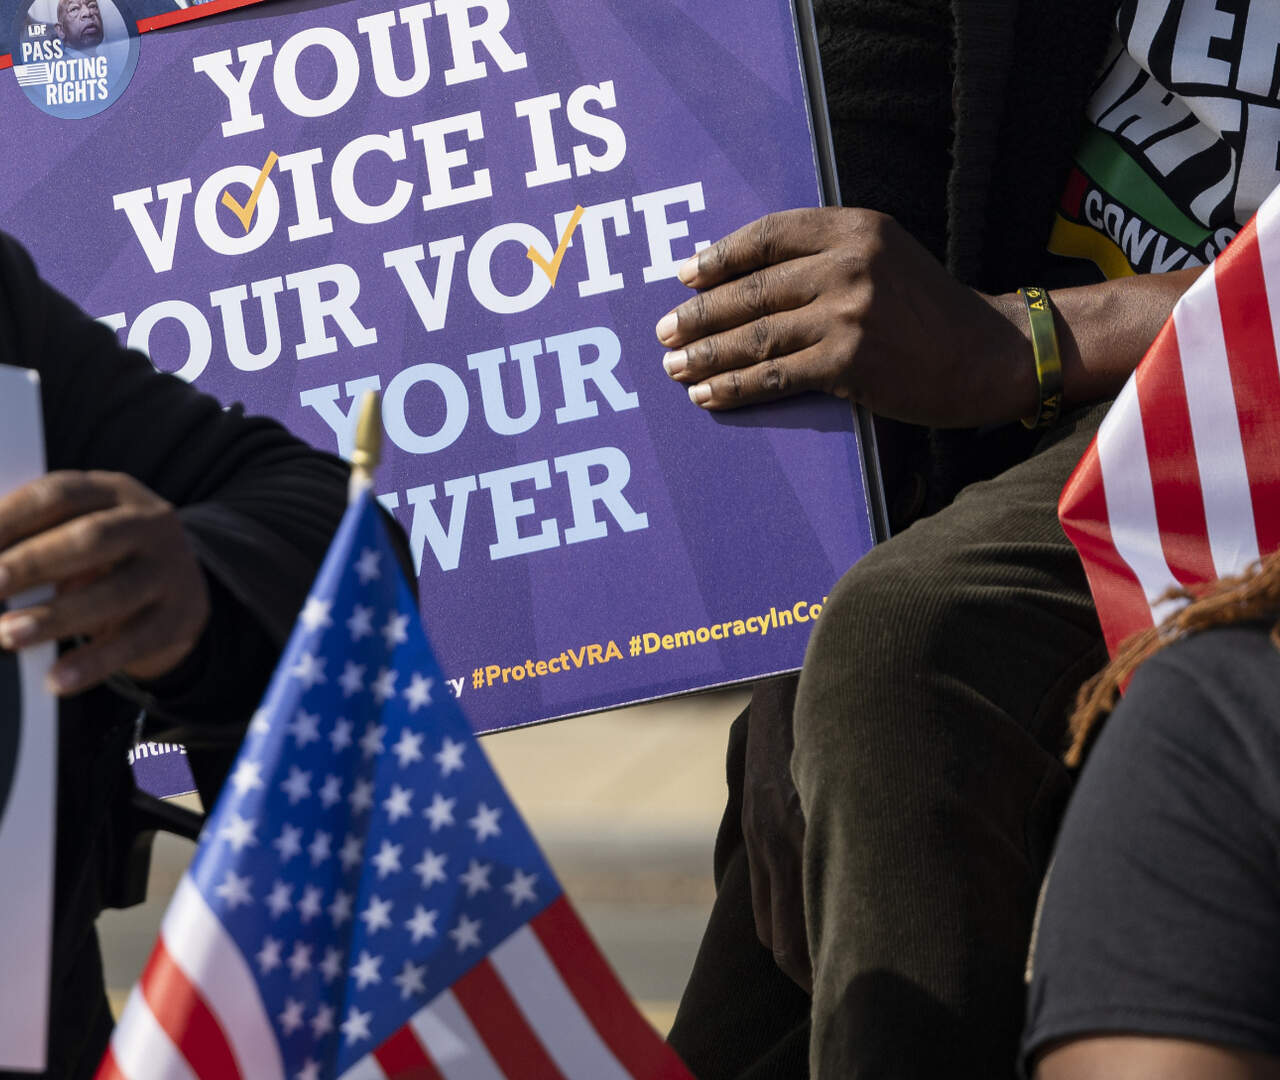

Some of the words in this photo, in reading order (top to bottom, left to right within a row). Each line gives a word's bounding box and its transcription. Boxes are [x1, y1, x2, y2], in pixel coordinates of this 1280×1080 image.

[22, 39, 63, 62] PASS
[28, 24, 47, 37] LDF
[45, 56, 108, 83] VOTING
[46, 79, 108, 105] RIGHTS
[112, 110, 492, 273] VOICE
[515, 80, 627, 189] IS
[95, 263, 378, 383] OUR
[383, 181, 713, 332] VOTE
[299, 326, 640, 461] YOUR
[377, 446, 649, 577] WER
[472, 640, 624, 689] #ProtectVRA
[629, 597, 829, 657] #DemocracyInCo
